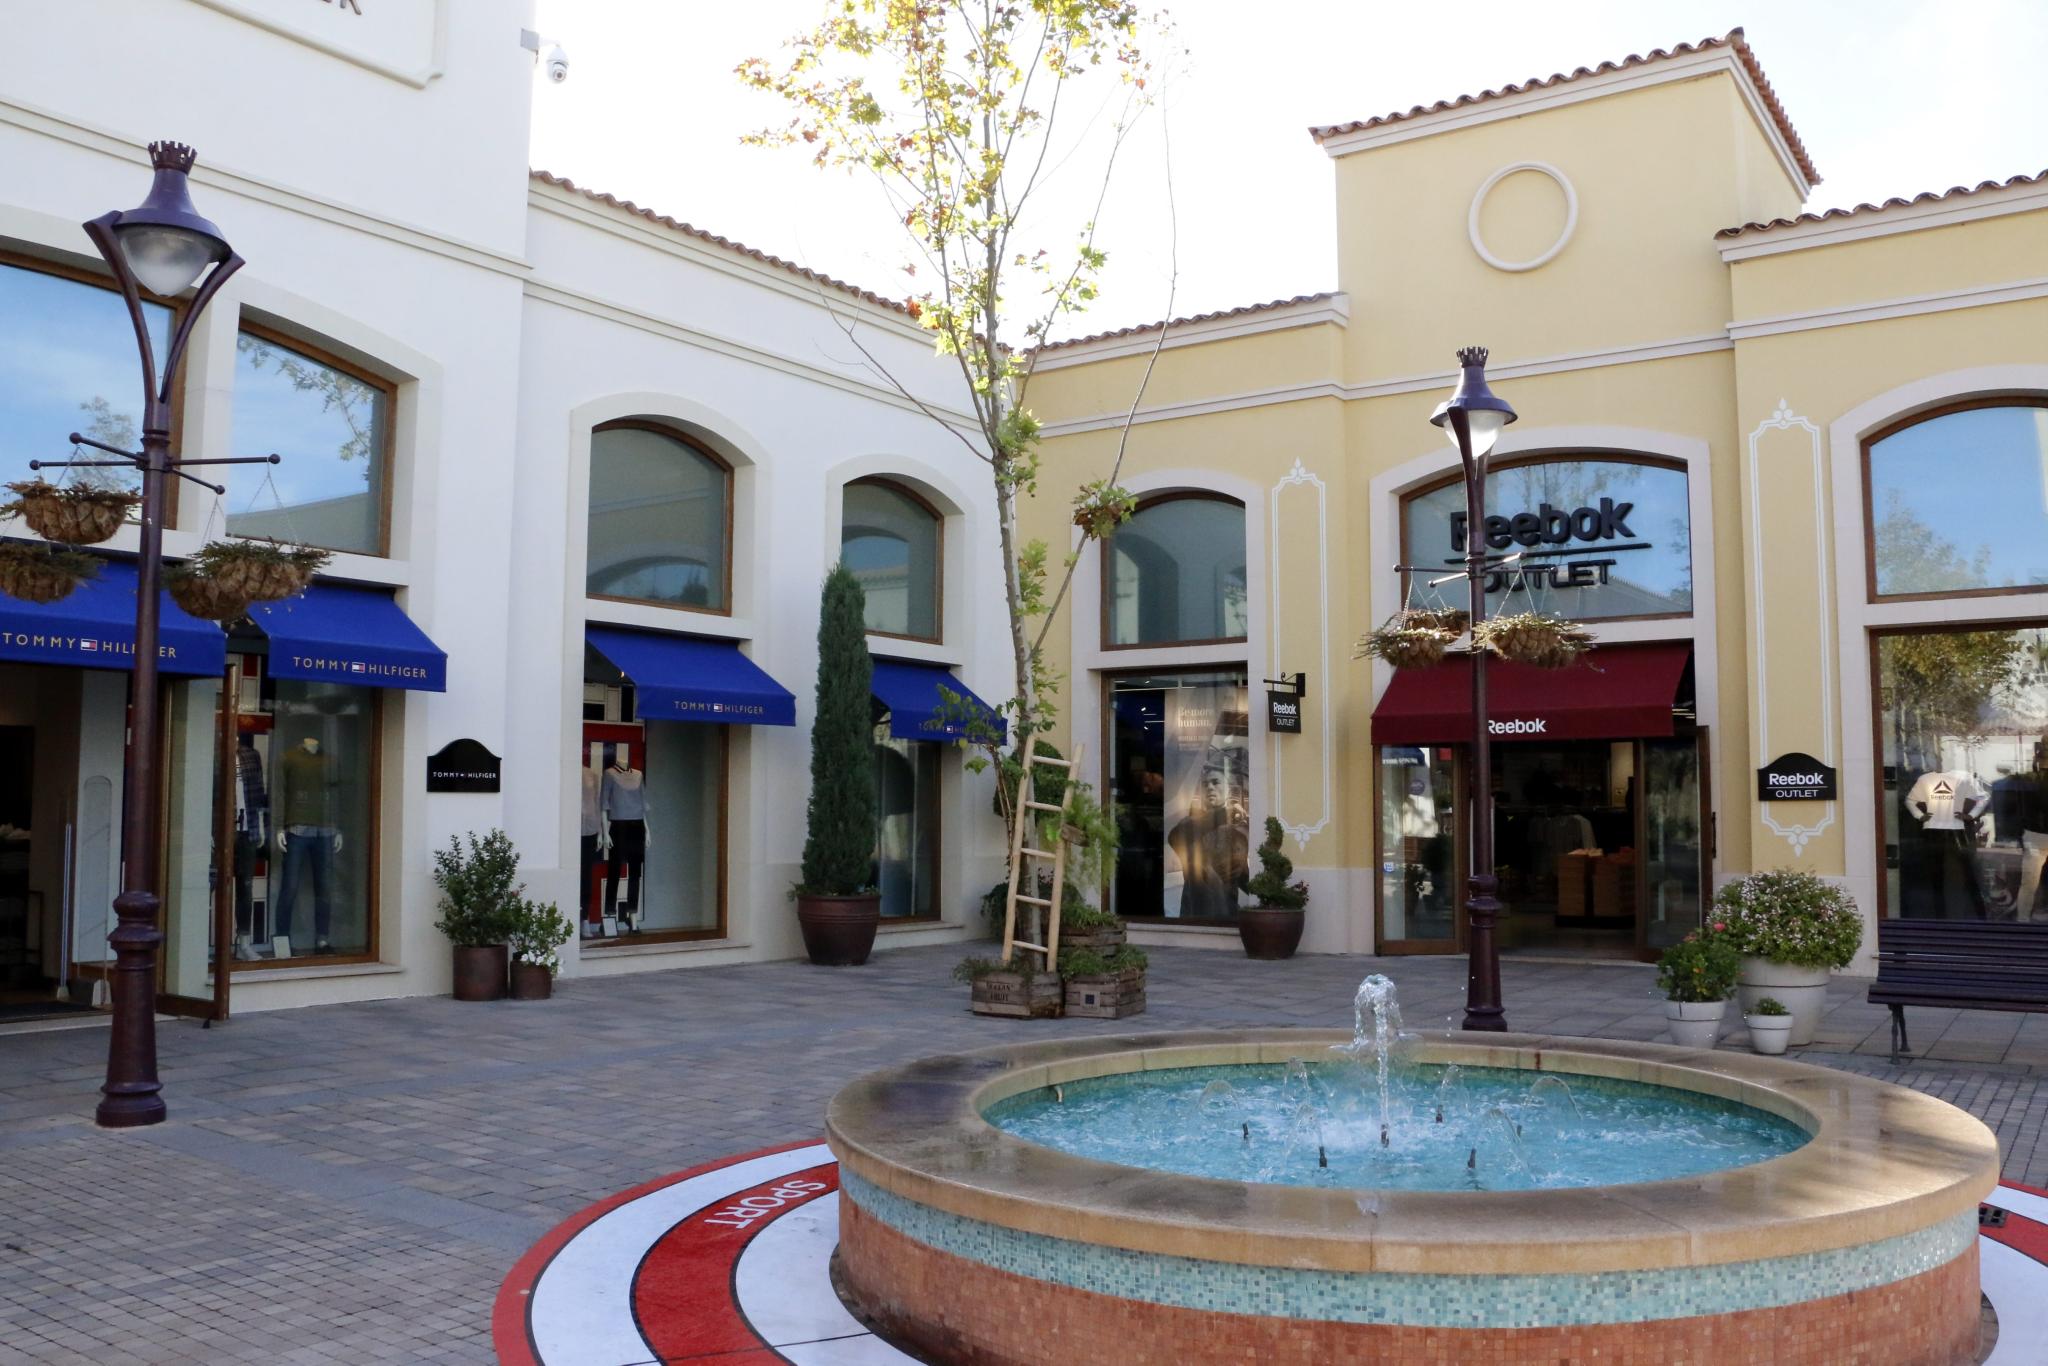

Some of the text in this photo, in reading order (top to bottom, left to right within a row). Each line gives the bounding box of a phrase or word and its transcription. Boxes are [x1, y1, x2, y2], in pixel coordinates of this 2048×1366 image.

[2, 632, 177, 658] TOMMY HILER
[293, 656, 427, 678] TOMMY HILFIGER
[673, 701, 763, 714] TOMMY HILFIGER
[1273, 702, 1297, 715] Reebok
[1276, 718, 1296, 727] OUTLET
[1488, 718, 1546, 734] Reebok
[1769, 772, 1824, 785] Reebok
[1775, 789, 1819, 798] OUTLET
[704, 1180, 826, 1229] SPORT
